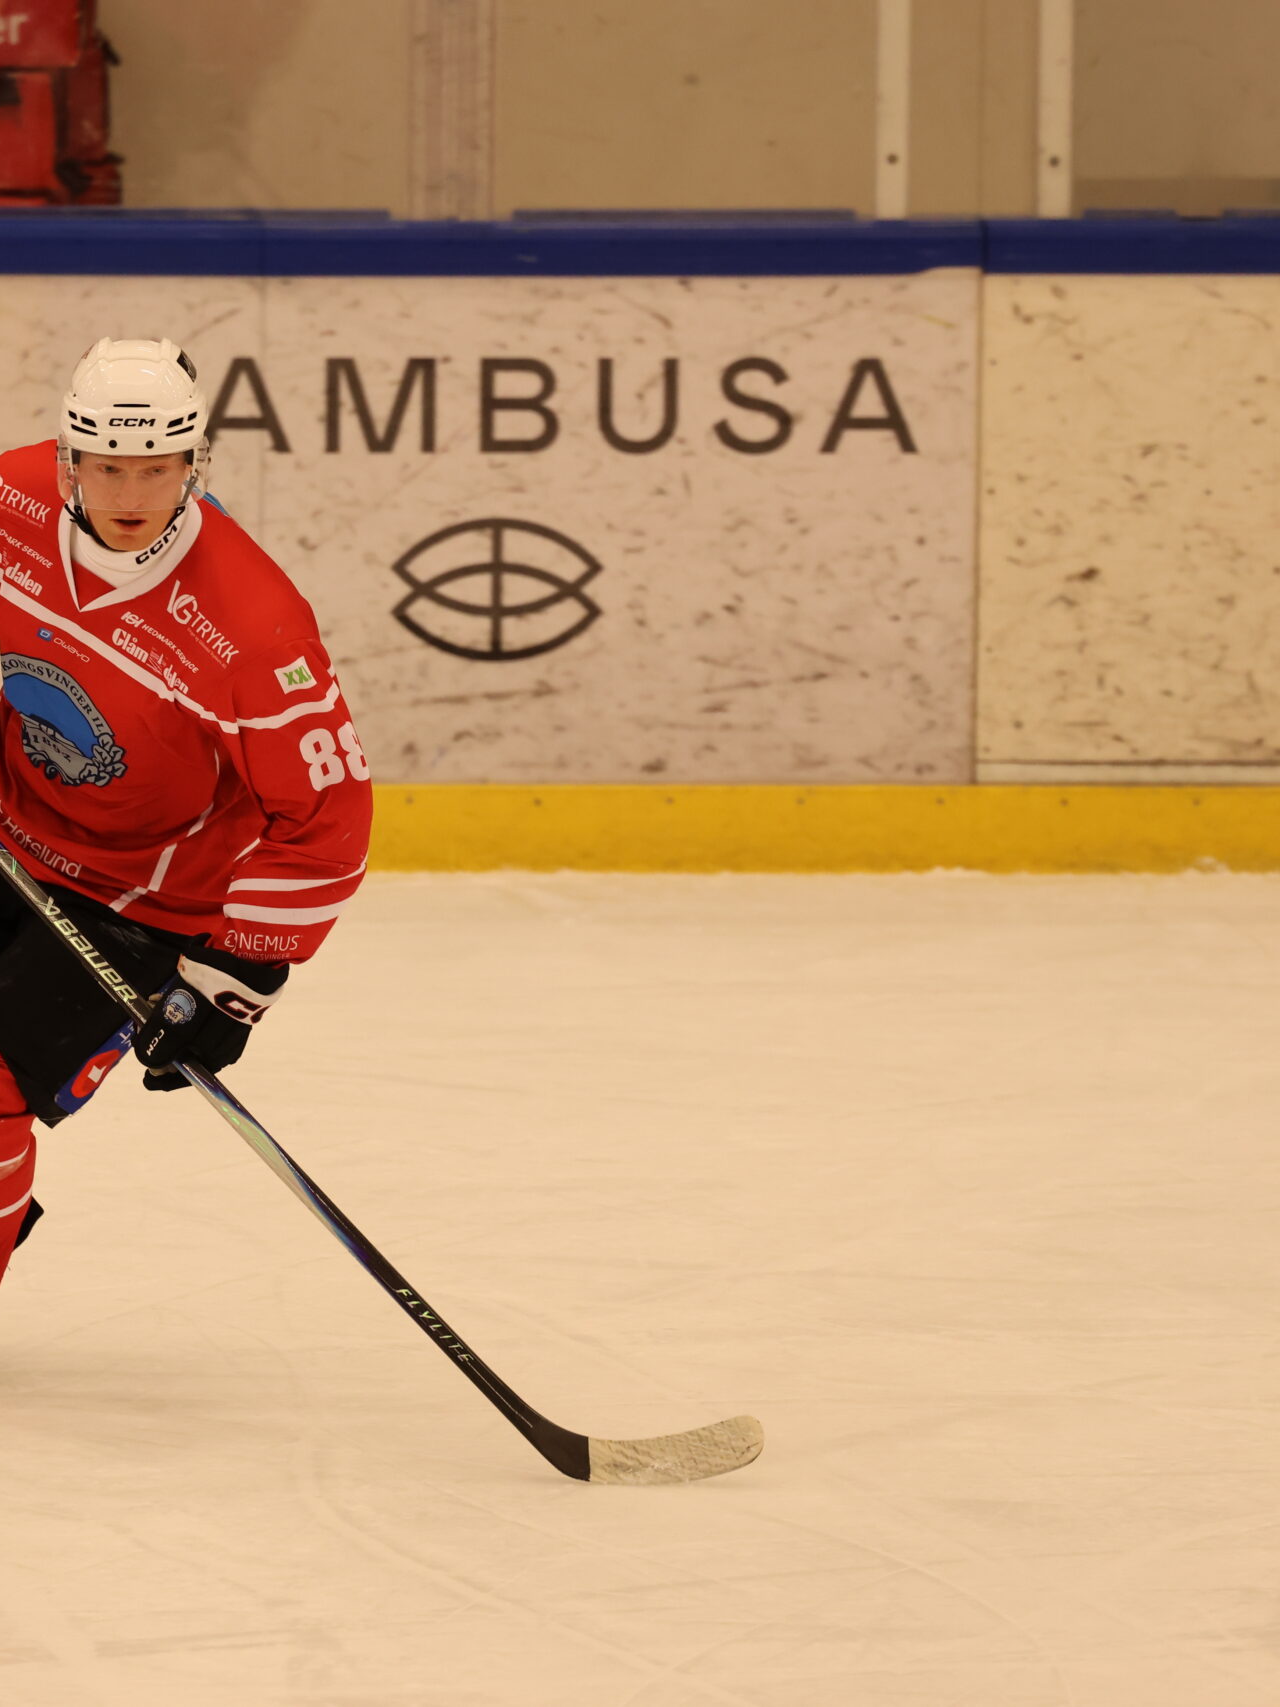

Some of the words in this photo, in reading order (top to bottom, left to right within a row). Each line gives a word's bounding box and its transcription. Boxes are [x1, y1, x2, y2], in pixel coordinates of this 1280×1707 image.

[108, 417, 156, 427] CCM
[206, 356, 918, 455] AMBUSA
[21, 545, 54, 569] SERVICE
[135, 524, 178, 566] CCM
[111, 627, 149, 664] Glåm
[141, 623, 177, 652] HEDMARK
[1, 657, 93, 715] KONGSVINGER
[91, 715, 104, 733] IL
[299, 720, 371, 792] 88
[1, 816, 83, 880] Hofslund
[395, 1287, 475, 1364] FLYLITE
